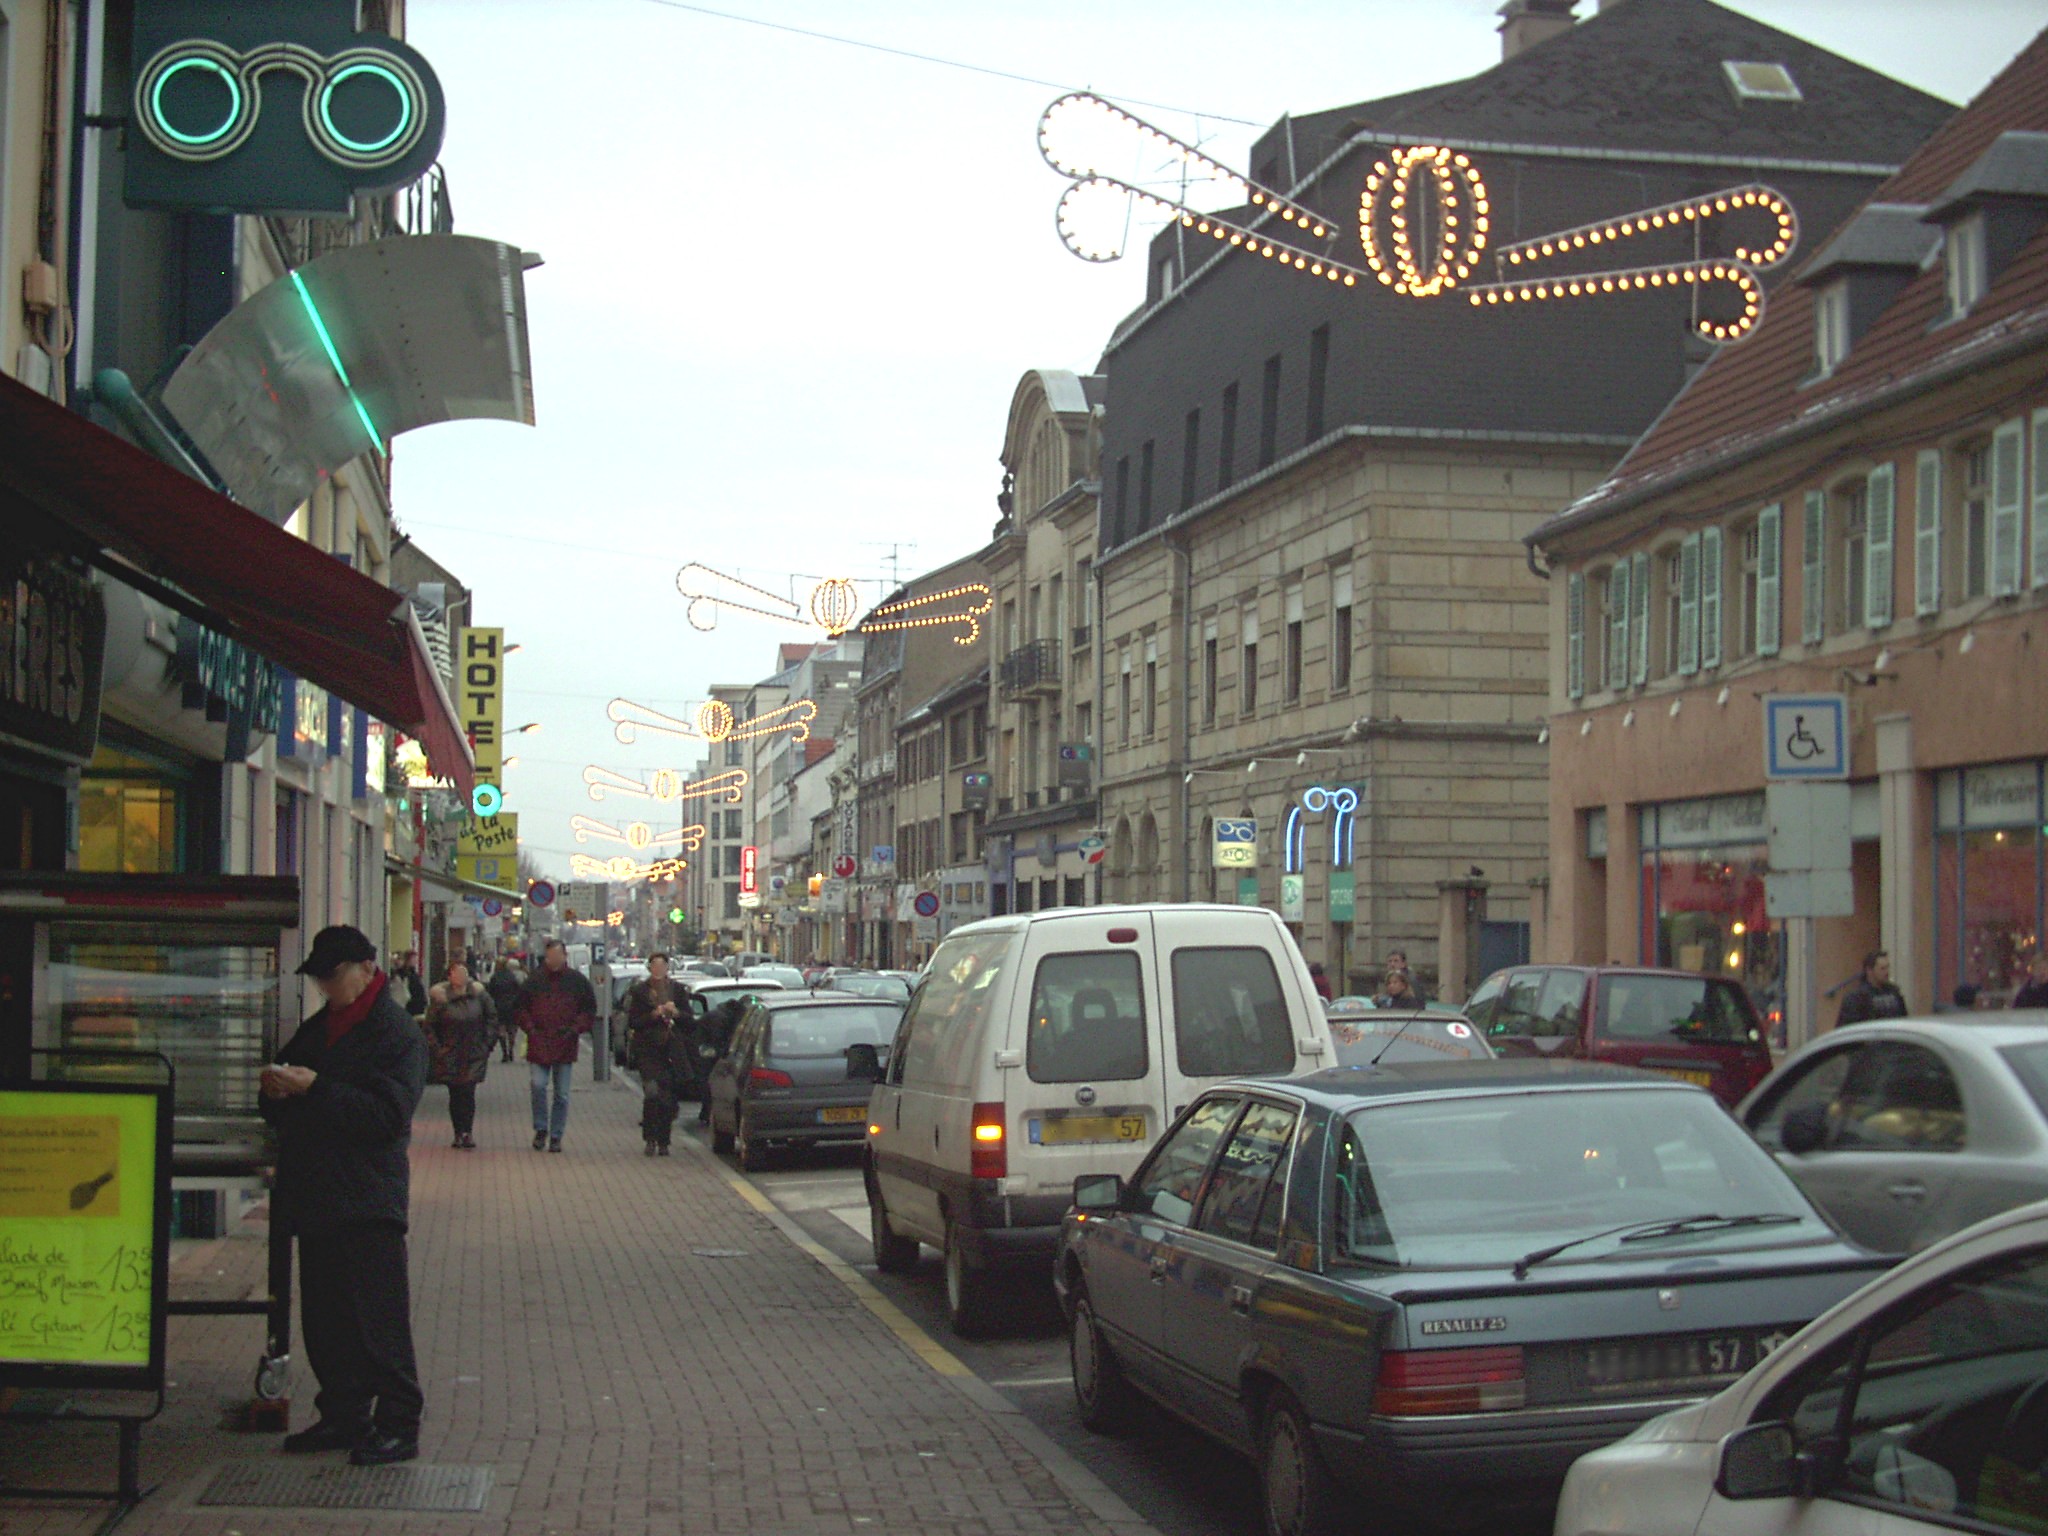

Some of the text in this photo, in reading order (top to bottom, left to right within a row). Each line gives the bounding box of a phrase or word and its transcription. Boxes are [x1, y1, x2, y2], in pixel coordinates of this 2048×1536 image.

[474, 826, 515, 851] Poste
[1454, 1024, 1466, 1036] A
[1120, 1118, 1142, 1138] 57
[1423, 1317, 1506, 1334] RENAULT 25
[1707, 1338, 1741, 1371] 57
